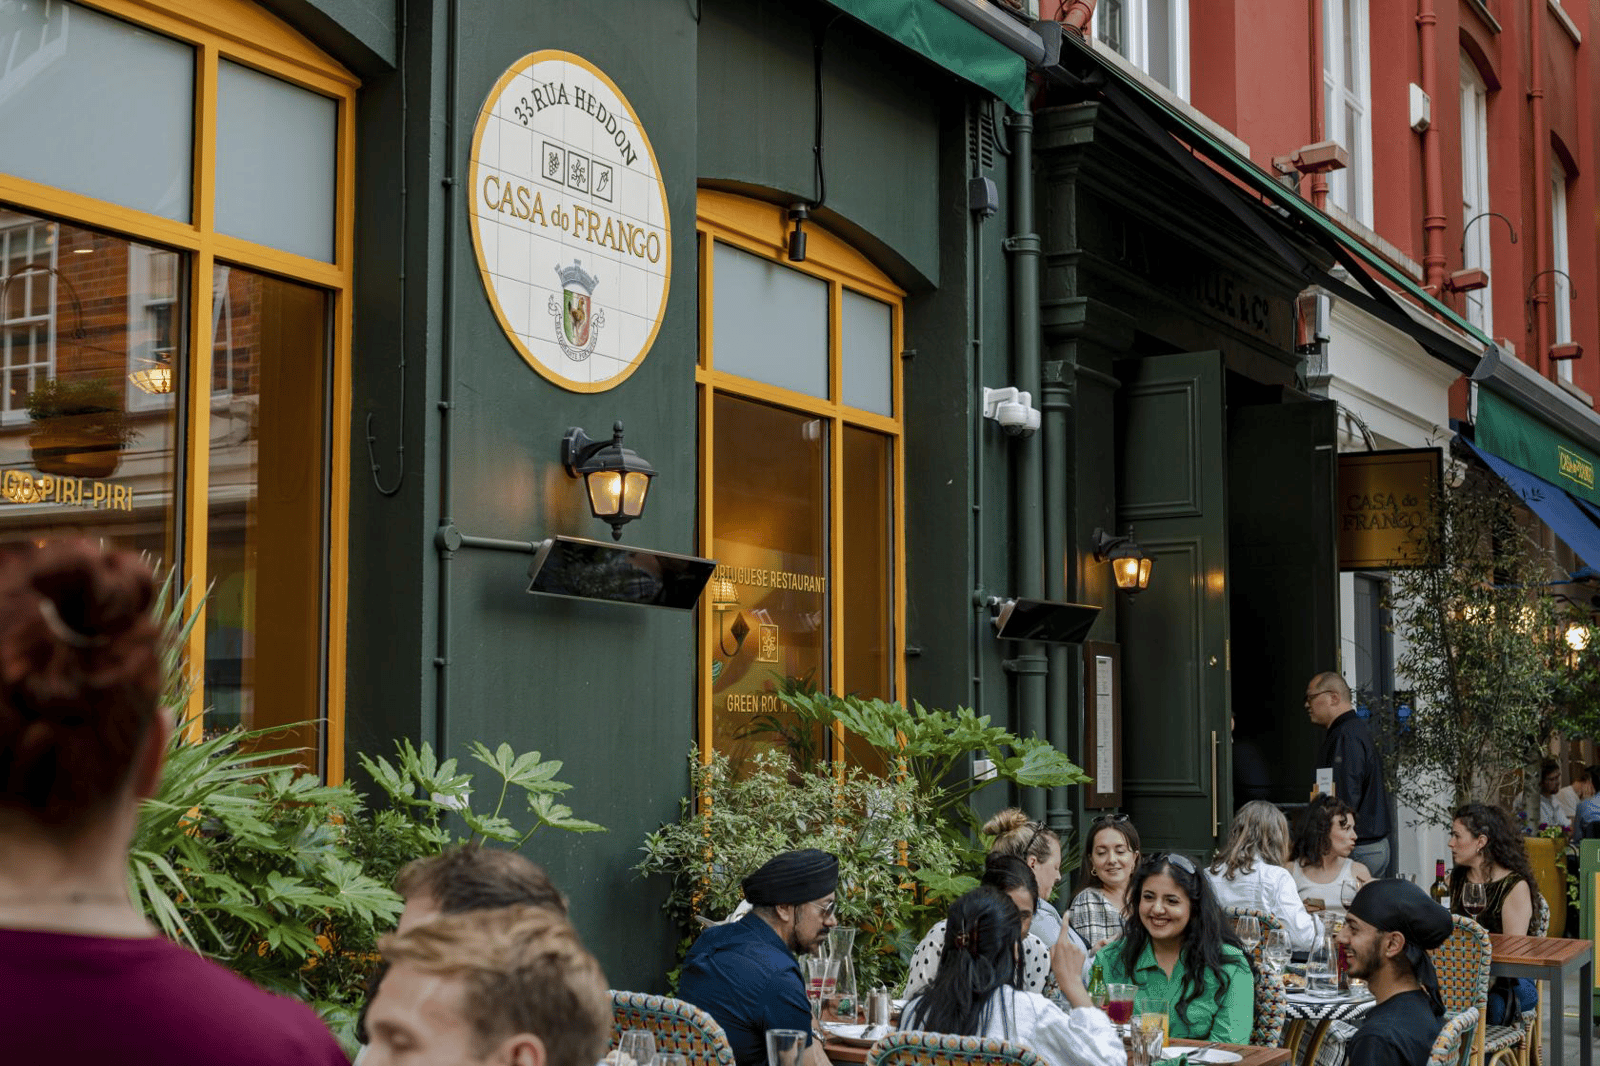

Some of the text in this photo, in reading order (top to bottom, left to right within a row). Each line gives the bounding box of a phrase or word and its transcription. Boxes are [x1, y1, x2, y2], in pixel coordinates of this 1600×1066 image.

[514, 82, 638, 166] 33 RUA HEDDON
[483, 175, 660, 264] CASA do FRANGO
[0, 470, 132, 512] GO PIRI-PIRI
[1346, 492, 1398, 511] CASA
[1342, 511, 1422, 531] FRANGO
[711, 564, 826, 594] ORTUGUESE RESTAURANT
[727, 694, 758, 713] GREEN
